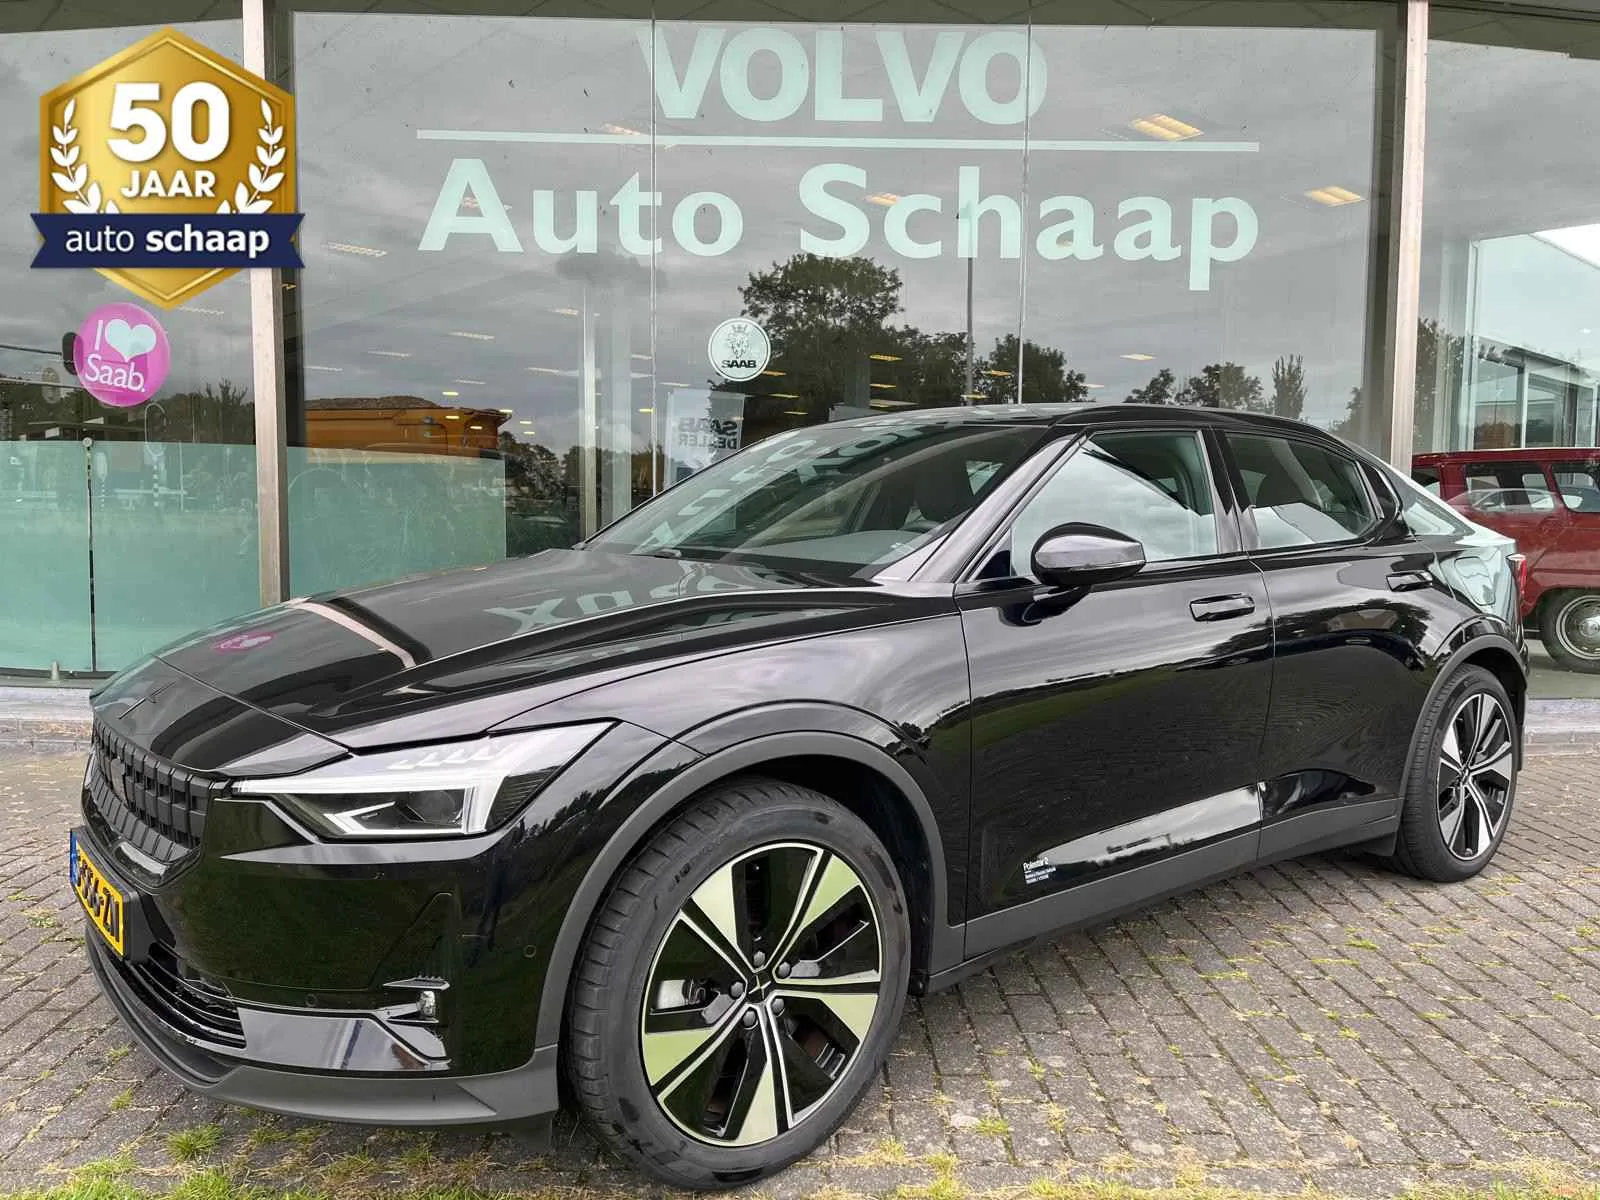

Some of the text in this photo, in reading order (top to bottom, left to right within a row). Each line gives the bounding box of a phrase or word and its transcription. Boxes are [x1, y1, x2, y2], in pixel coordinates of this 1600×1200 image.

[639, 26, 1048, 126] VOLVO
[418, 157, 1260, 291] Auto Schaap
[93, 319, 104, 351] I
[721, 359, 757, 369] SAAB
